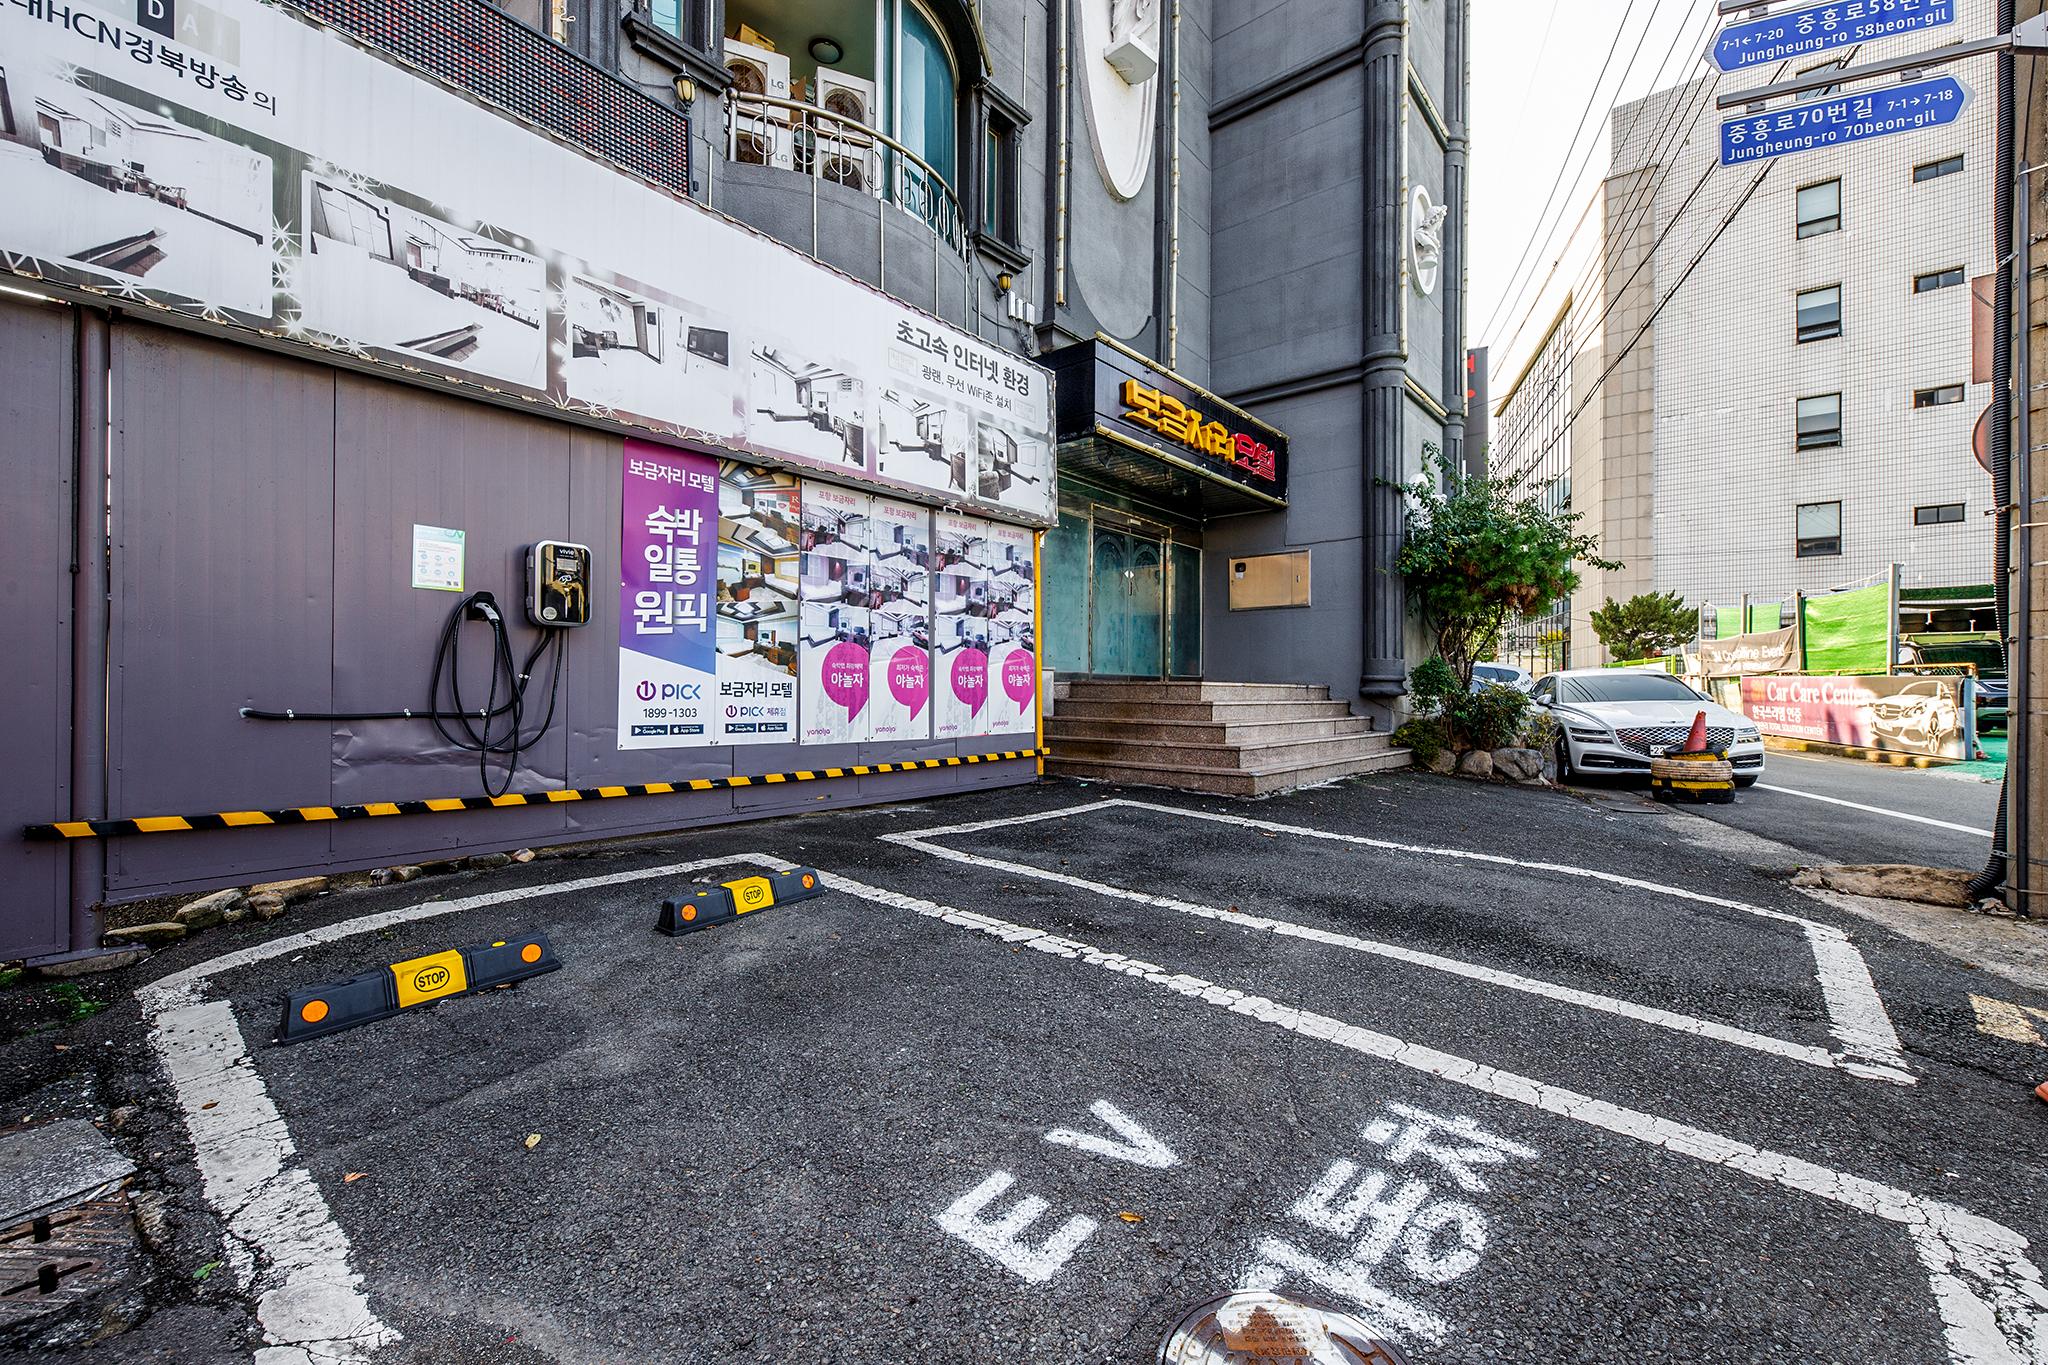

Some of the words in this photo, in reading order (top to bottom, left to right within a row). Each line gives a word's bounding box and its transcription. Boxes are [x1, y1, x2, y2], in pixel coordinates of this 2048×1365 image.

[1738, 30, 1848, 65] Jungheung-ro
[1855, 8, 1947, 39] 58beon-gil
[1753, 28, 1784, 42] 7-20
[771, 79, 784, 90] LG
[1923, 89, 1954, 105] 7-18
[1727, 97, 1873, 145] 중흥로70번길
[1728, 128, 1837, 161] Jungheung-ro
[1844, 110, 1937, 138] 70beon-gil
[775, 153, 788, 163] LG
[896, 319, 949, 363] 초고속
[954, 344, 999, 384] 인터넷
[1003, 366, 1030, 397] 환경
[947, 375, 966, 393] 무선
[995, 395, 1013, 412] 설치
[628, 458, 686, 487] 보금자리
[687, 471, 715, 494] 모텔
[832, 493, 856, 506] 보금자리
[644, 504, 704, 546] 숙박
[643, 544, 702, 586] 일통
[633, 589, 708, 635] 원픽
[831, 671, 864, 688] 야놀자
[896, 673, 925, 689] 야놀자
[958, 674, 984, 689] 야놀자
[1008, 673, 1031, 687] 야놀자
[719, 681, 768, 698] 보금자리
[770, 682, 793, 698] 모텔
[1767, 681, 1788, 702] Car
[1790, 681, 1820, 704] Care
[744, 887, 762, 903] STOP
[416, 970, 446, 986] STOP
